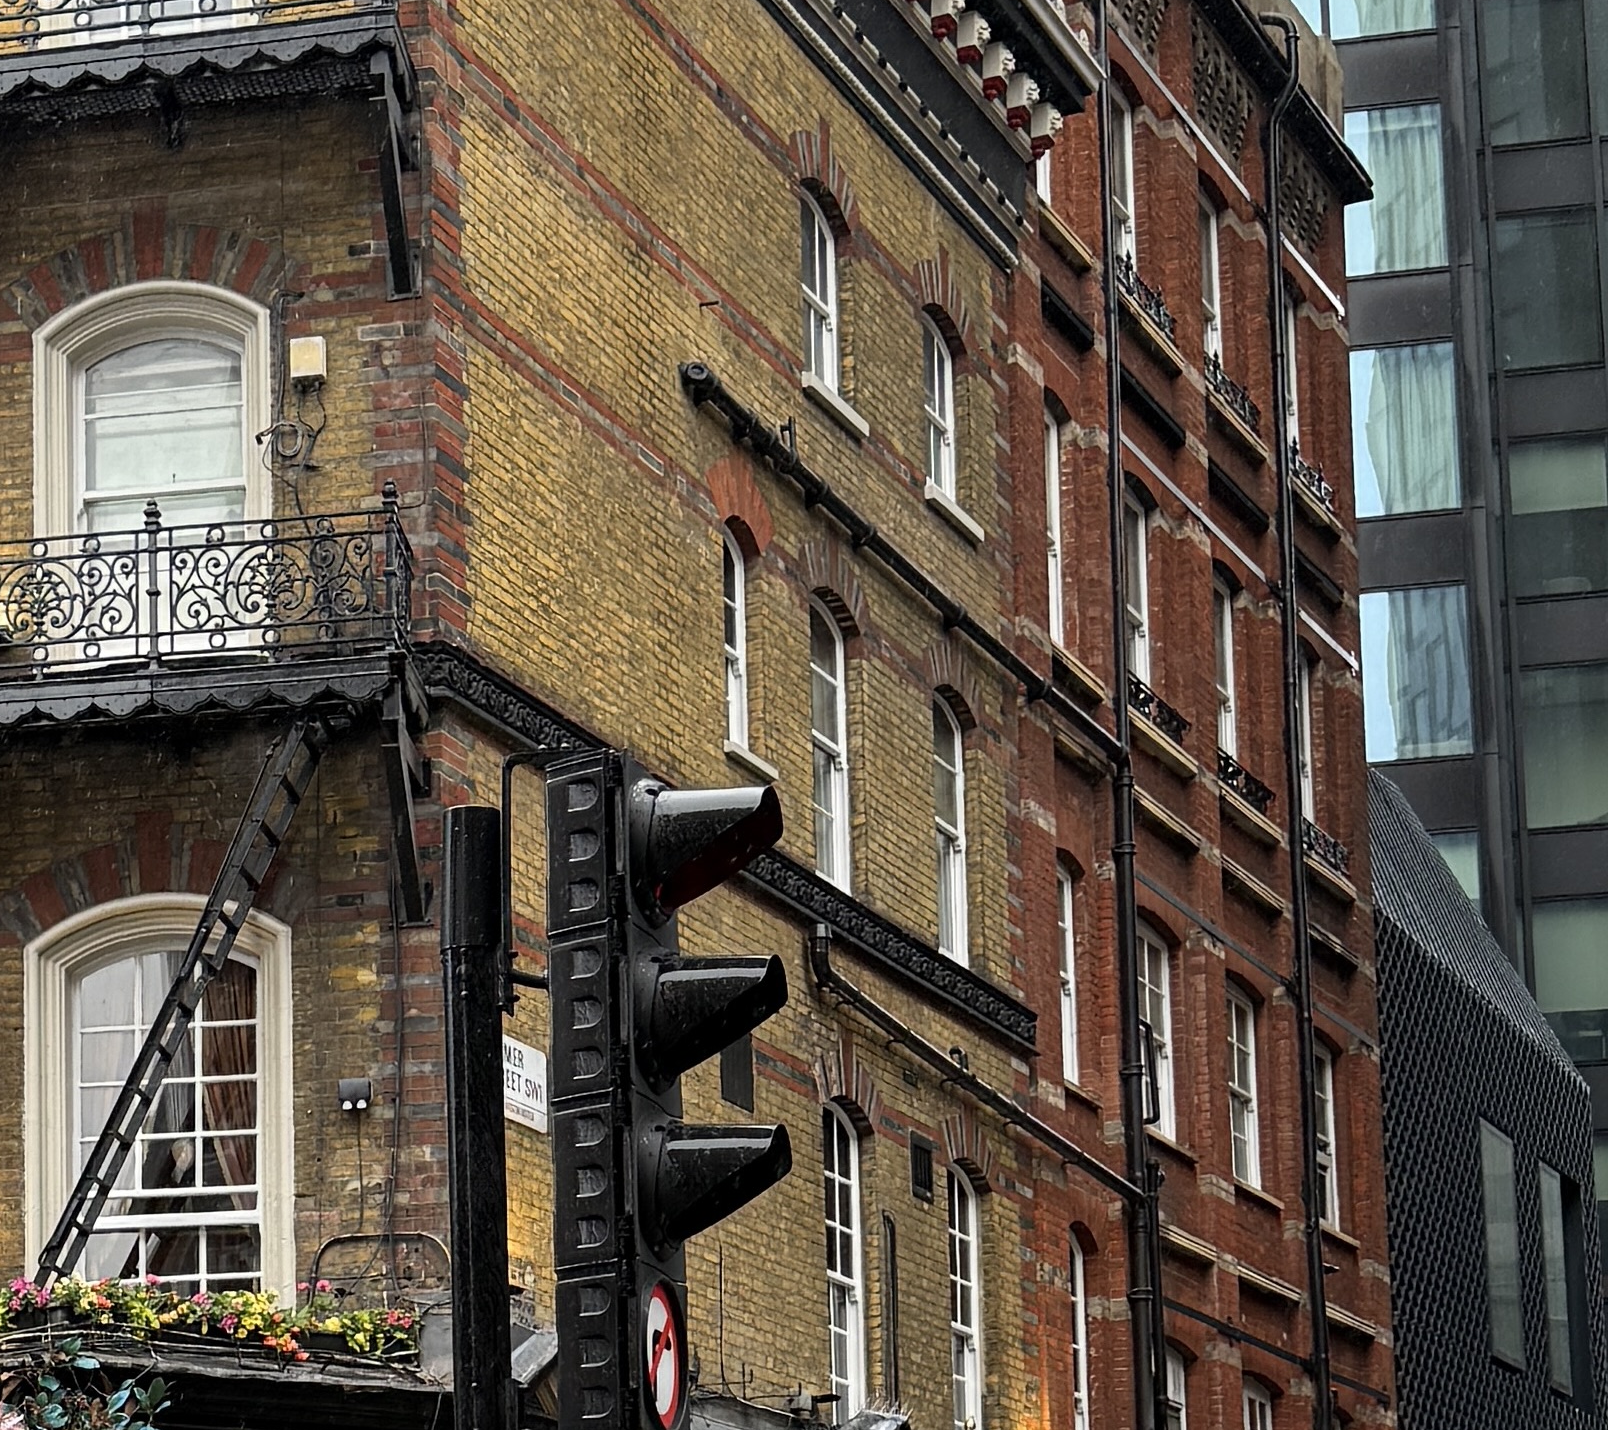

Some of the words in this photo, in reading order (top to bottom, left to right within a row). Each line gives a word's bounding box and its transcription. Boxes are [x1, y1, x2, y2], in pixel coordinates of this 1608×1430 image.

[503, 1042, 524, 1071] MER
[506, 1069, 522, 1093] EET
[524, 1078, 543, 1104] SW1
